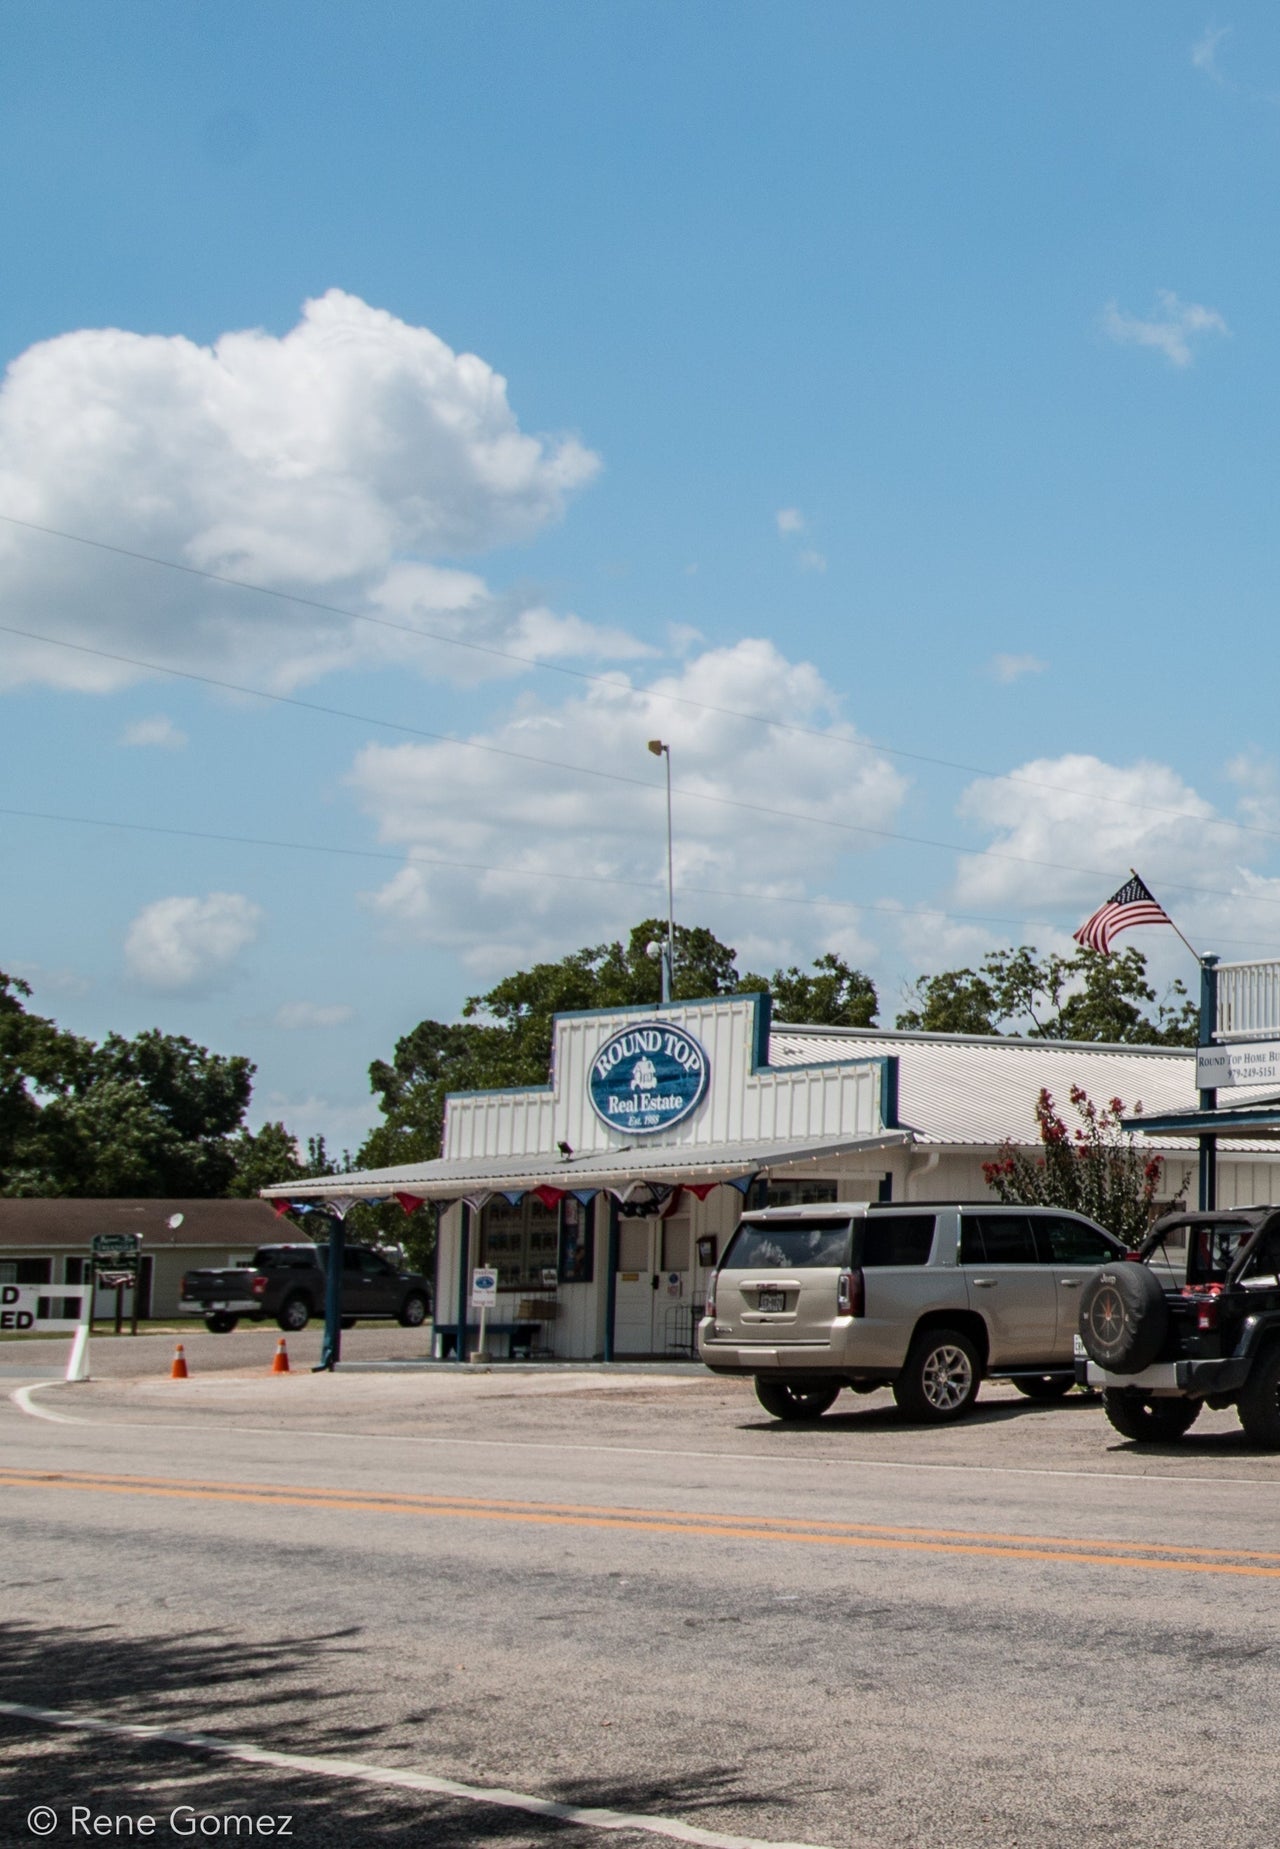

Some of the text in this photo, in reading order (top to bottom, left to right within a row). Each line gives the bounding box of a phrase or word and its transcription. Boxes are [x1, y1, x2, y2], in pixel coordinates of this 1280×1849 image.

[595, 1030, 700, 1080] ROUND TOP
[1198, 1056, 1225, 1068] ROUND
[1226, 1054, 1242, 1066] TOP
[1243, 1053, 1267, 1064] HOME
[1227, 1066, 1276, 1079] 979-249-5151
[608, 1093, 683, 1114] Real Estate
